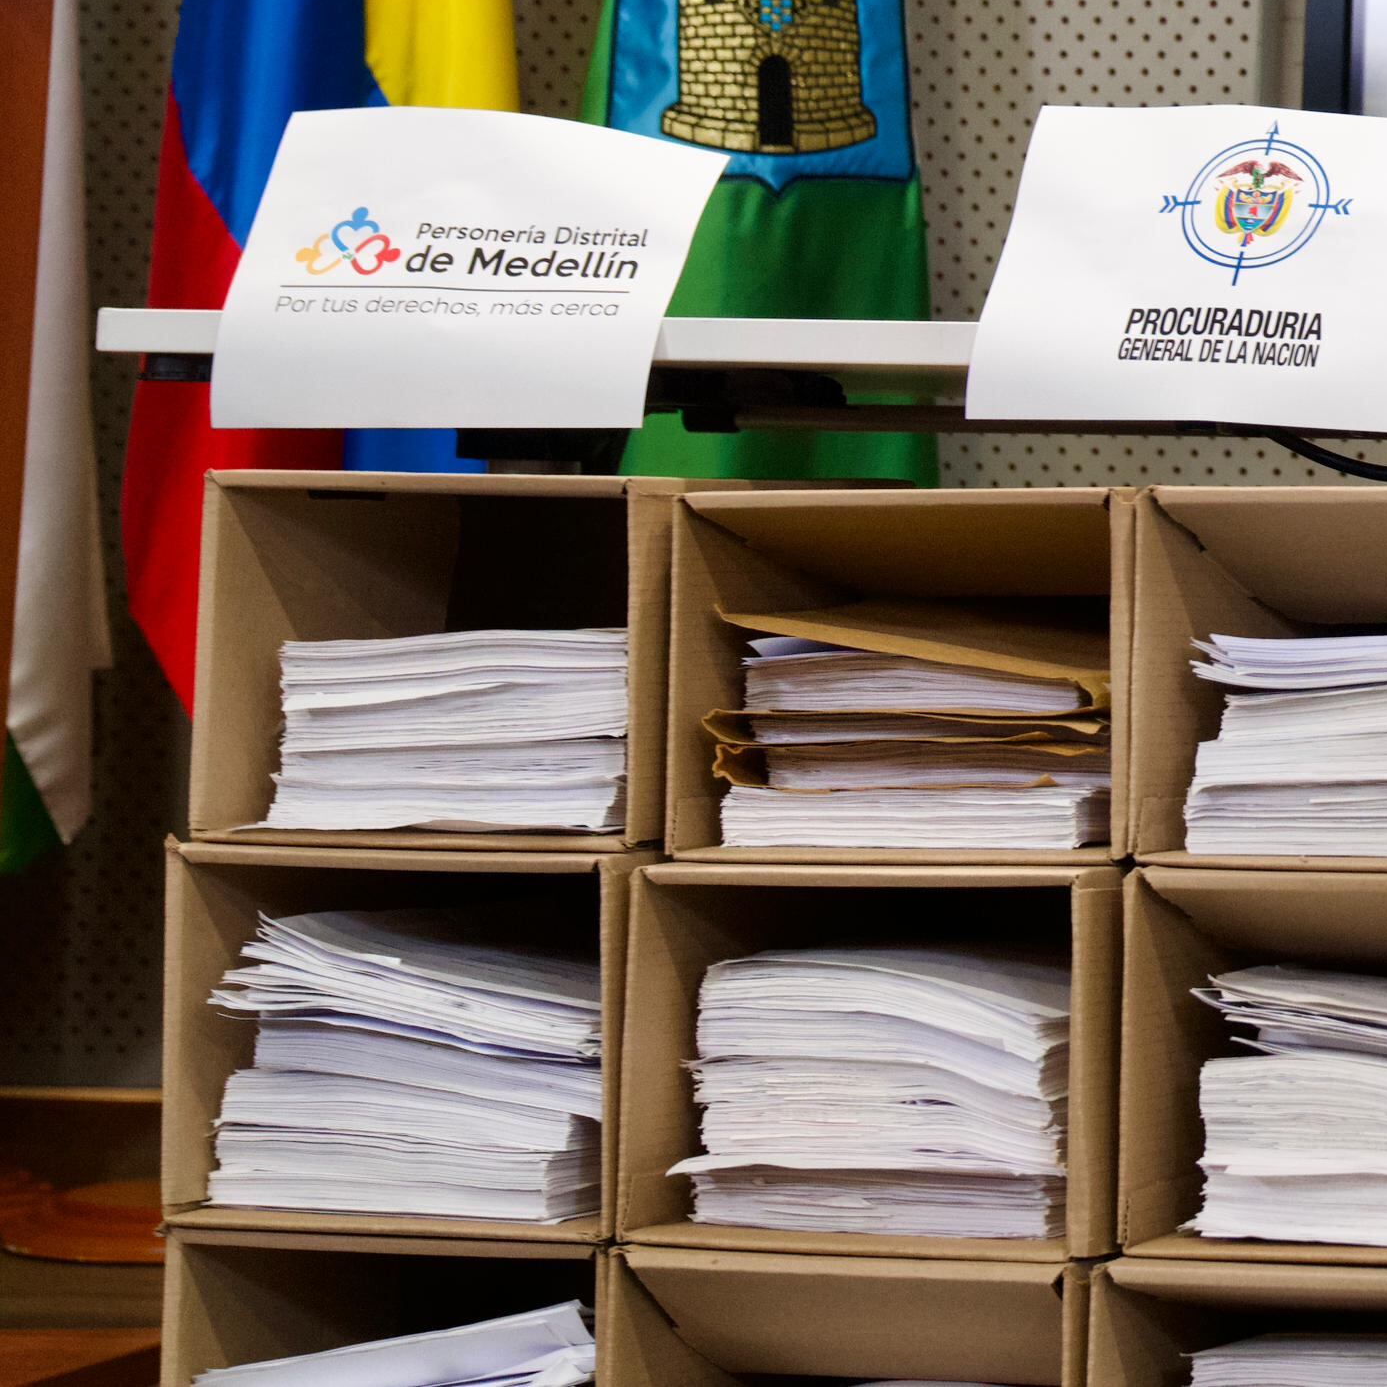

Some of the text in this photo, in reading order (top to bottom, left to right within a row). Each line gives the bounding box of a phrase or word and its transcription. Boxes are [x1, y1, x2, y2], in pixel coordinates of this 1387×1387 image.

[416, 223, 648, 247] Personería Distrital
[406, 245, 639, 279] de Medellín
[275, 296, 619, 317] Por tus derechos, más cerca
[1125, 307, 1321, 340] PROCURADURIA
[1118, 338, 1319, 367] GENERAL DE LA NACION
